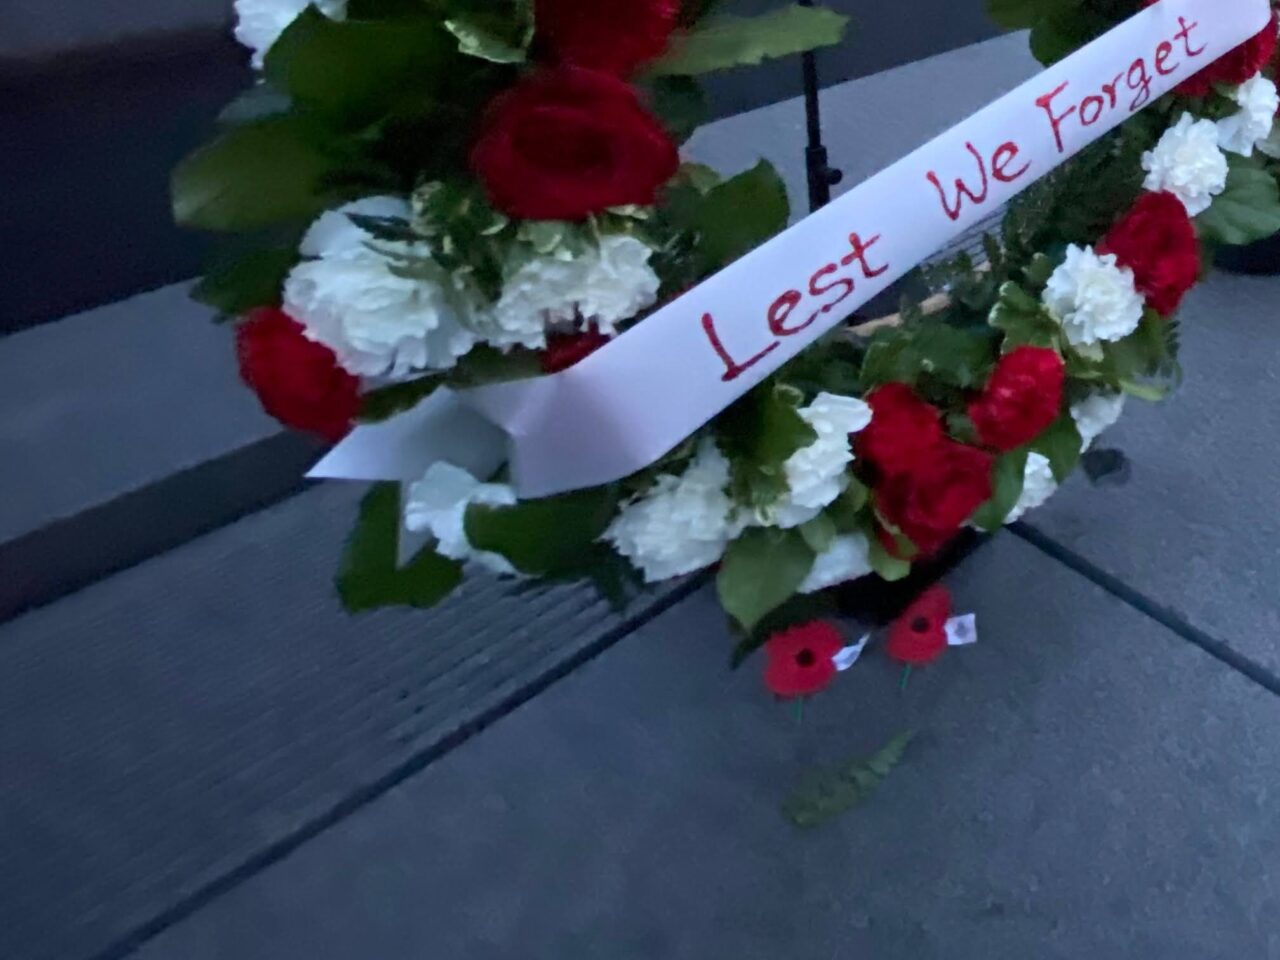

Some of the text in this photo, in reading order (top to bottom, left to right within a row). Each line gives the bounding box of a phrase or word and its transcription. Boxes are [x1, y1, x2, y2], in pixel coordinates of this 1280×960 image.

[701, 16, 1206, 382] Lest We Forget
